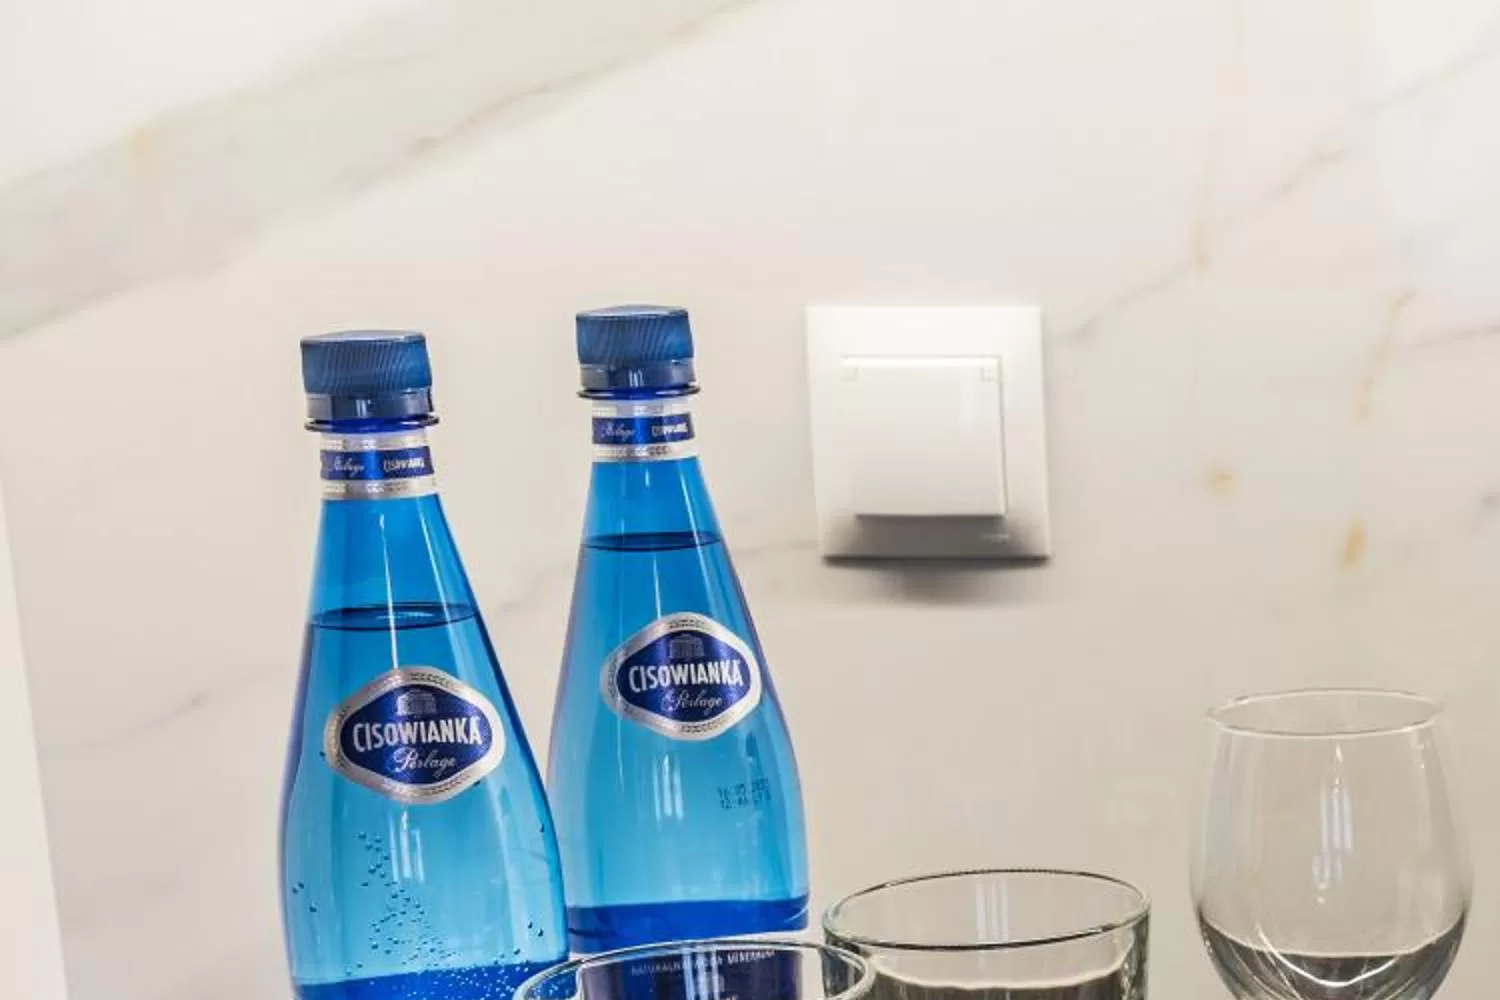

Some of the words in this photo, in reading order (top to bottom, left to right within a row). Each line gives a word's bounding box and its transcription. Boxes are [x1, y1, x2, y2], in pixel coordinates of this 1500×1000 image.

[628, 659, 744, 694] CISOWIANKA
[352, 716, 483, 753] CISOWIANKA
[391, 747, 456, 779] Perlage
